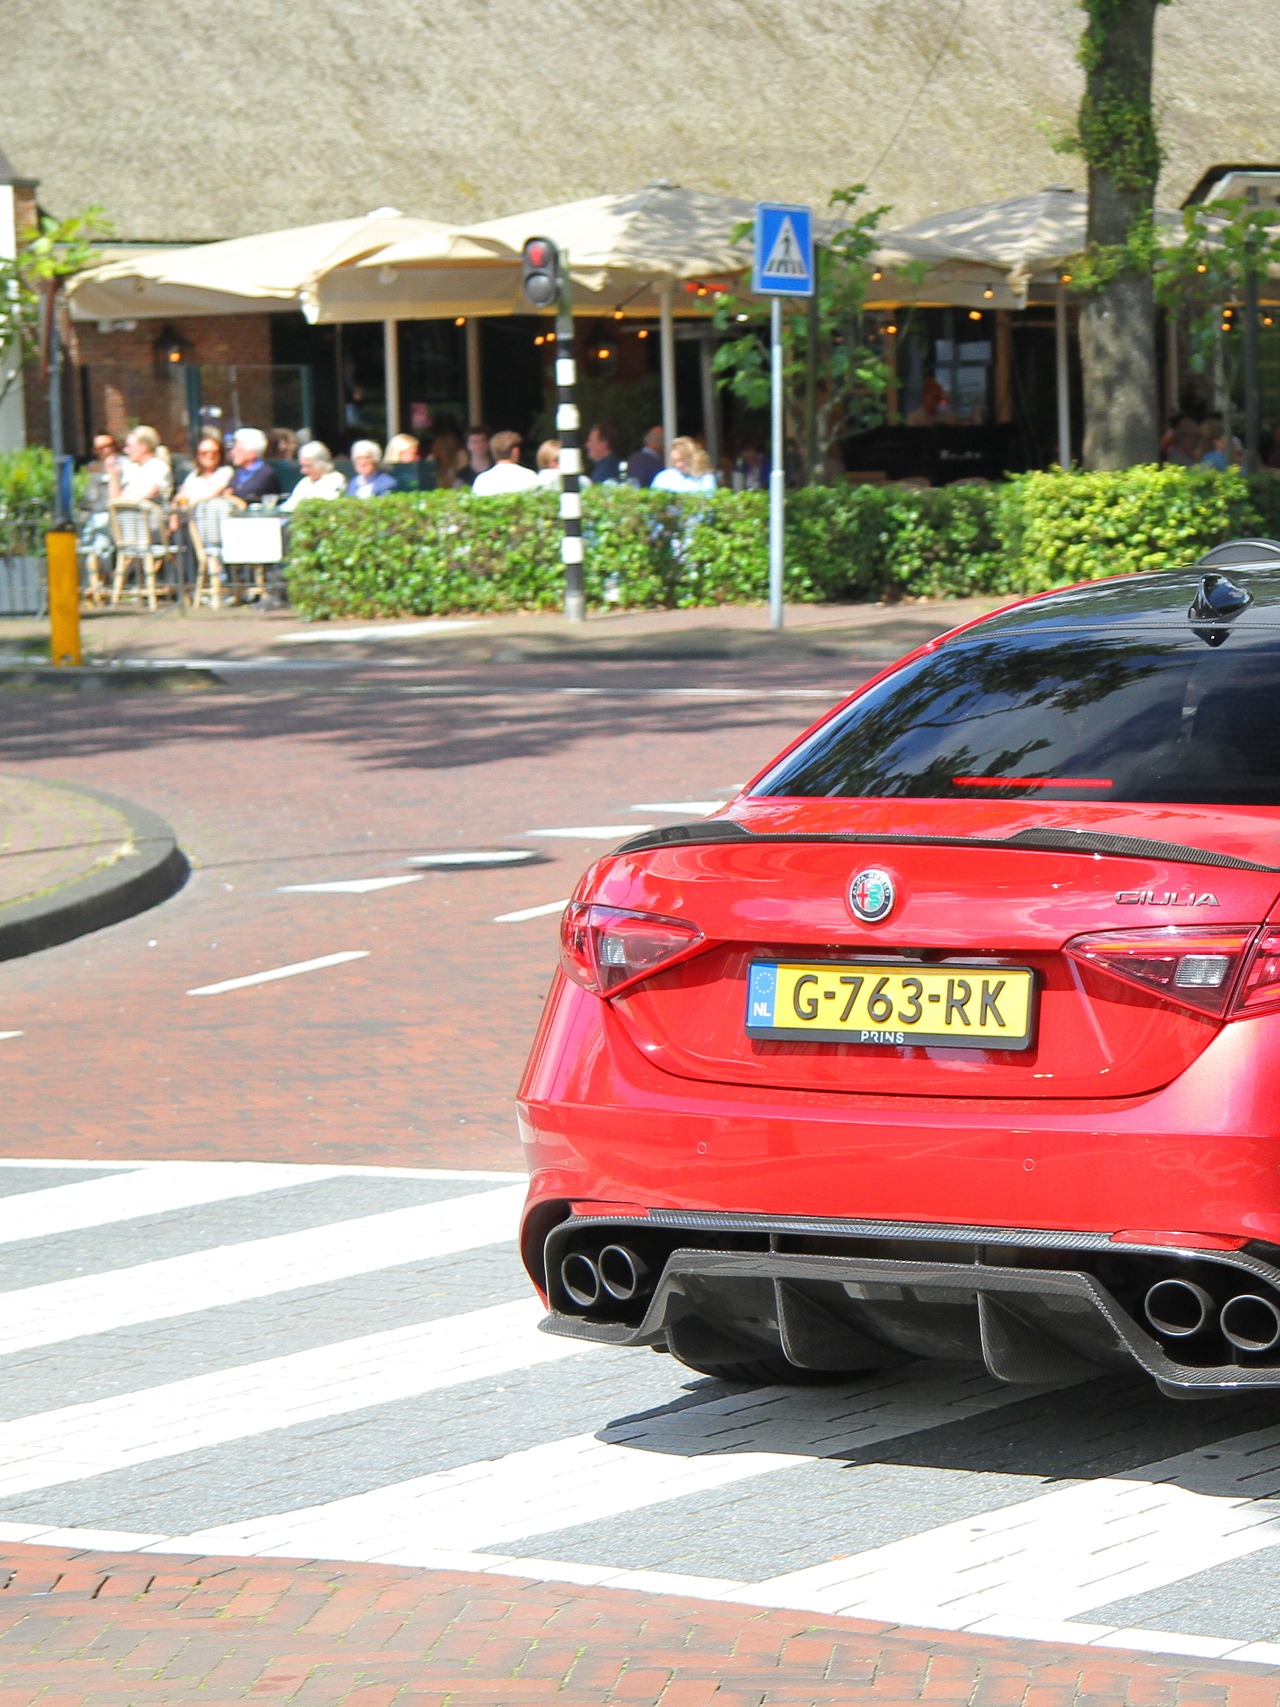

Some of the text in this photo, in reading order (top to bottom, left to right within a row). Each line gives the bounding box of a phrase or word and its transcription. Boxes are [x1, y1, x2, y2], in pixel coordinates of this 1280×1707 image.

[1115, 890, 1220, 906] GIULIA
[753, 974, 1006, 1027] NL G-763-RK
[860, 1031, 904, 1044] PRINS
